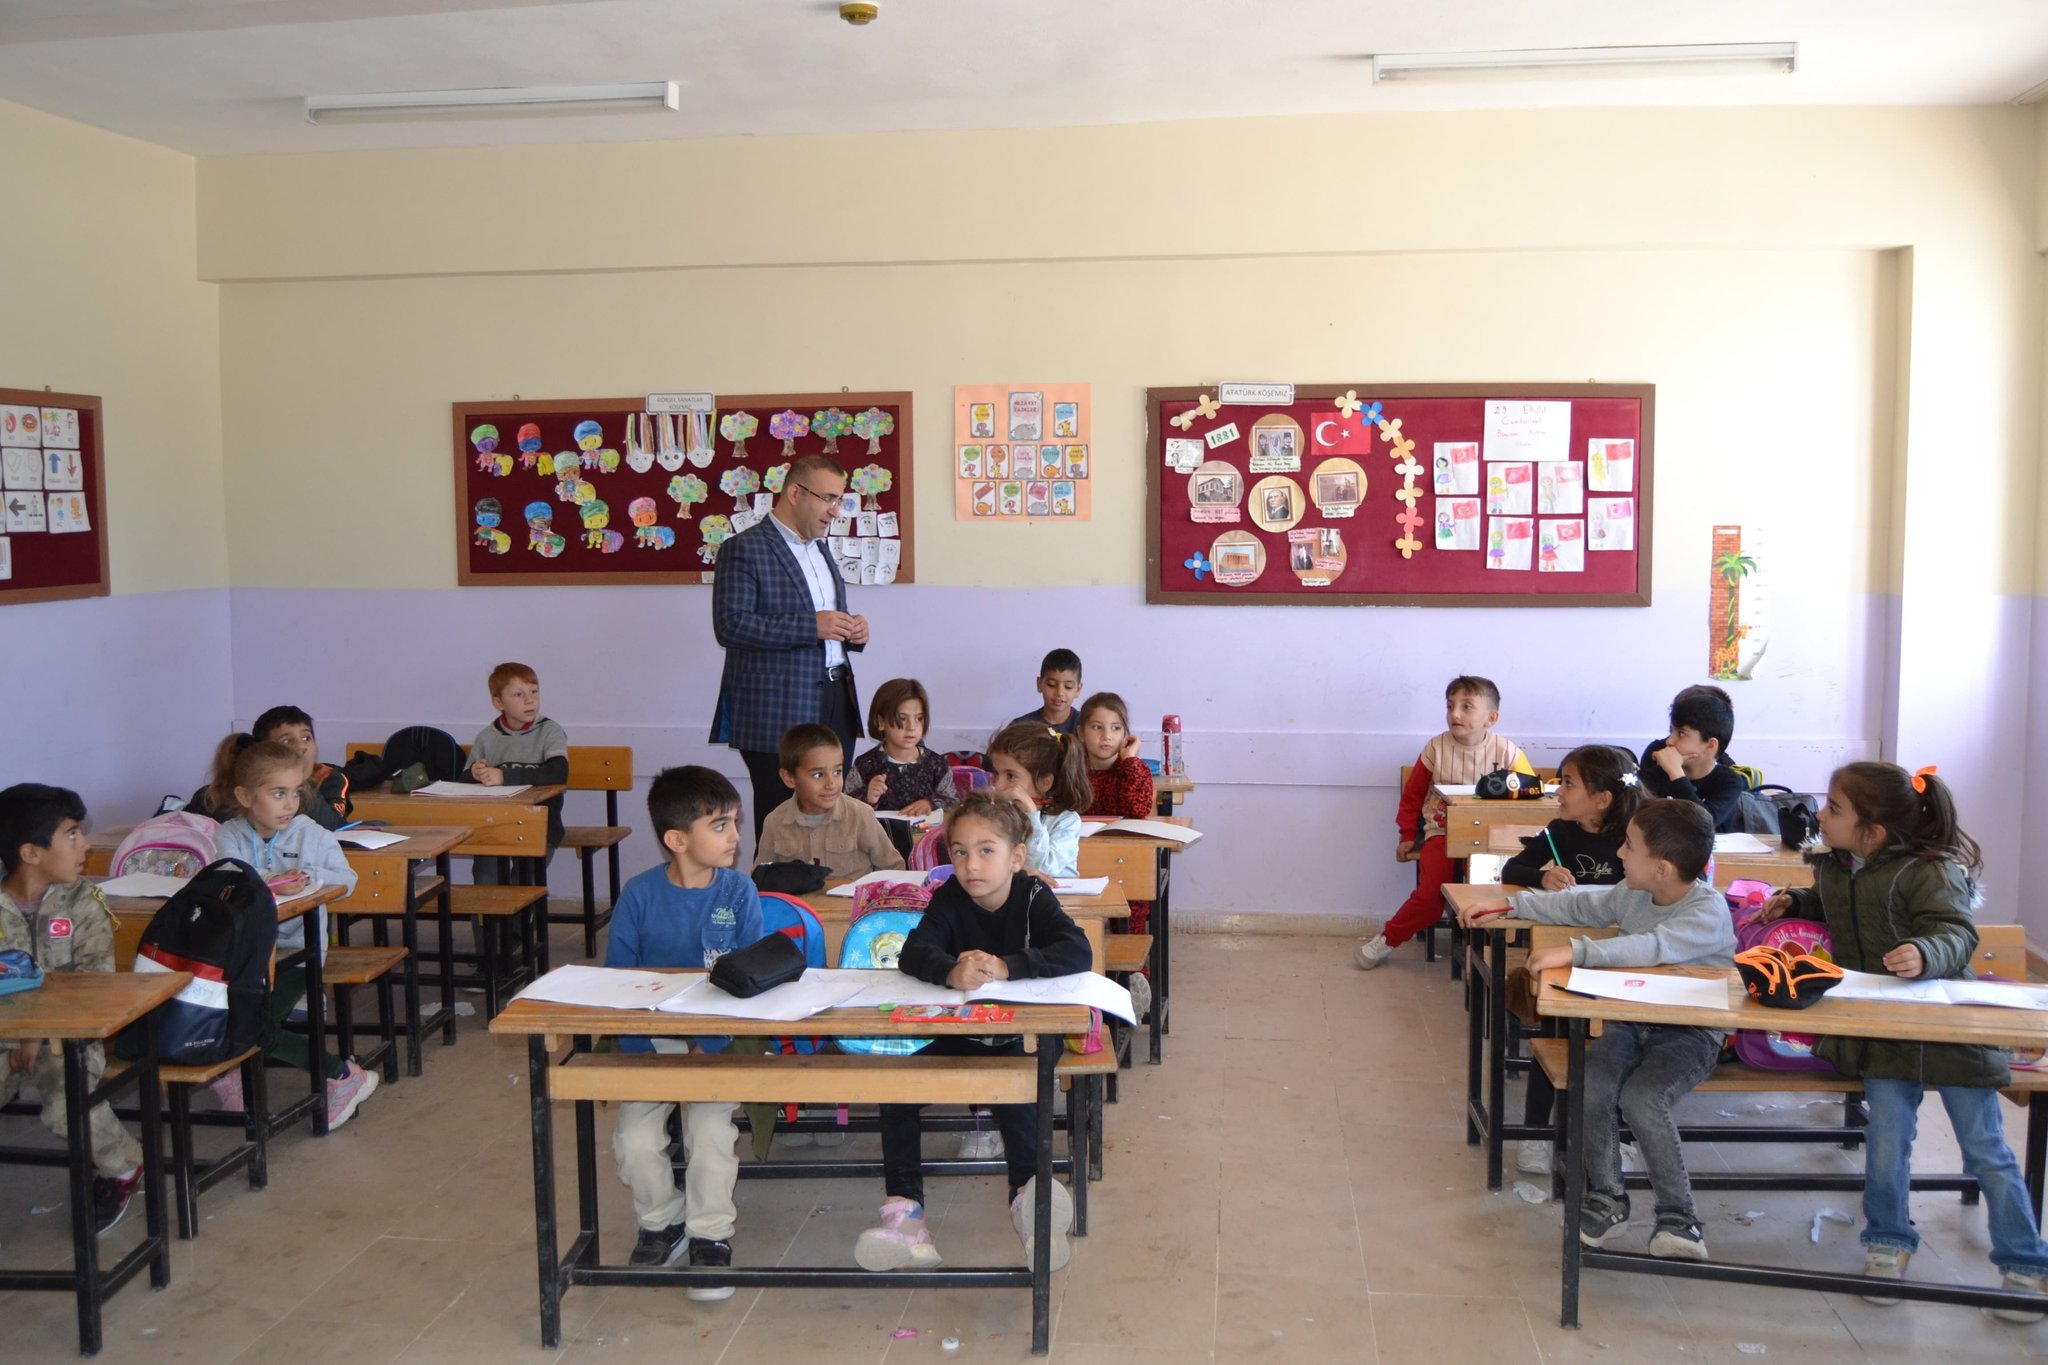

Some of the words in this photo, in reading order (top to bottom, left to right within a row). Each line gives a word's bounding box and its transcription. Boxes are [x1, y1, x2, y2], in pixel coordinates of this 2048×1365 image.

[1225, 388, 1256, 396] ATATÜRK
[1257, 388, 1288, 397] KÖŞEMİZ
[1493, 405, 1507, 414] 29
[1210, 428, 1235, 445] 1881
